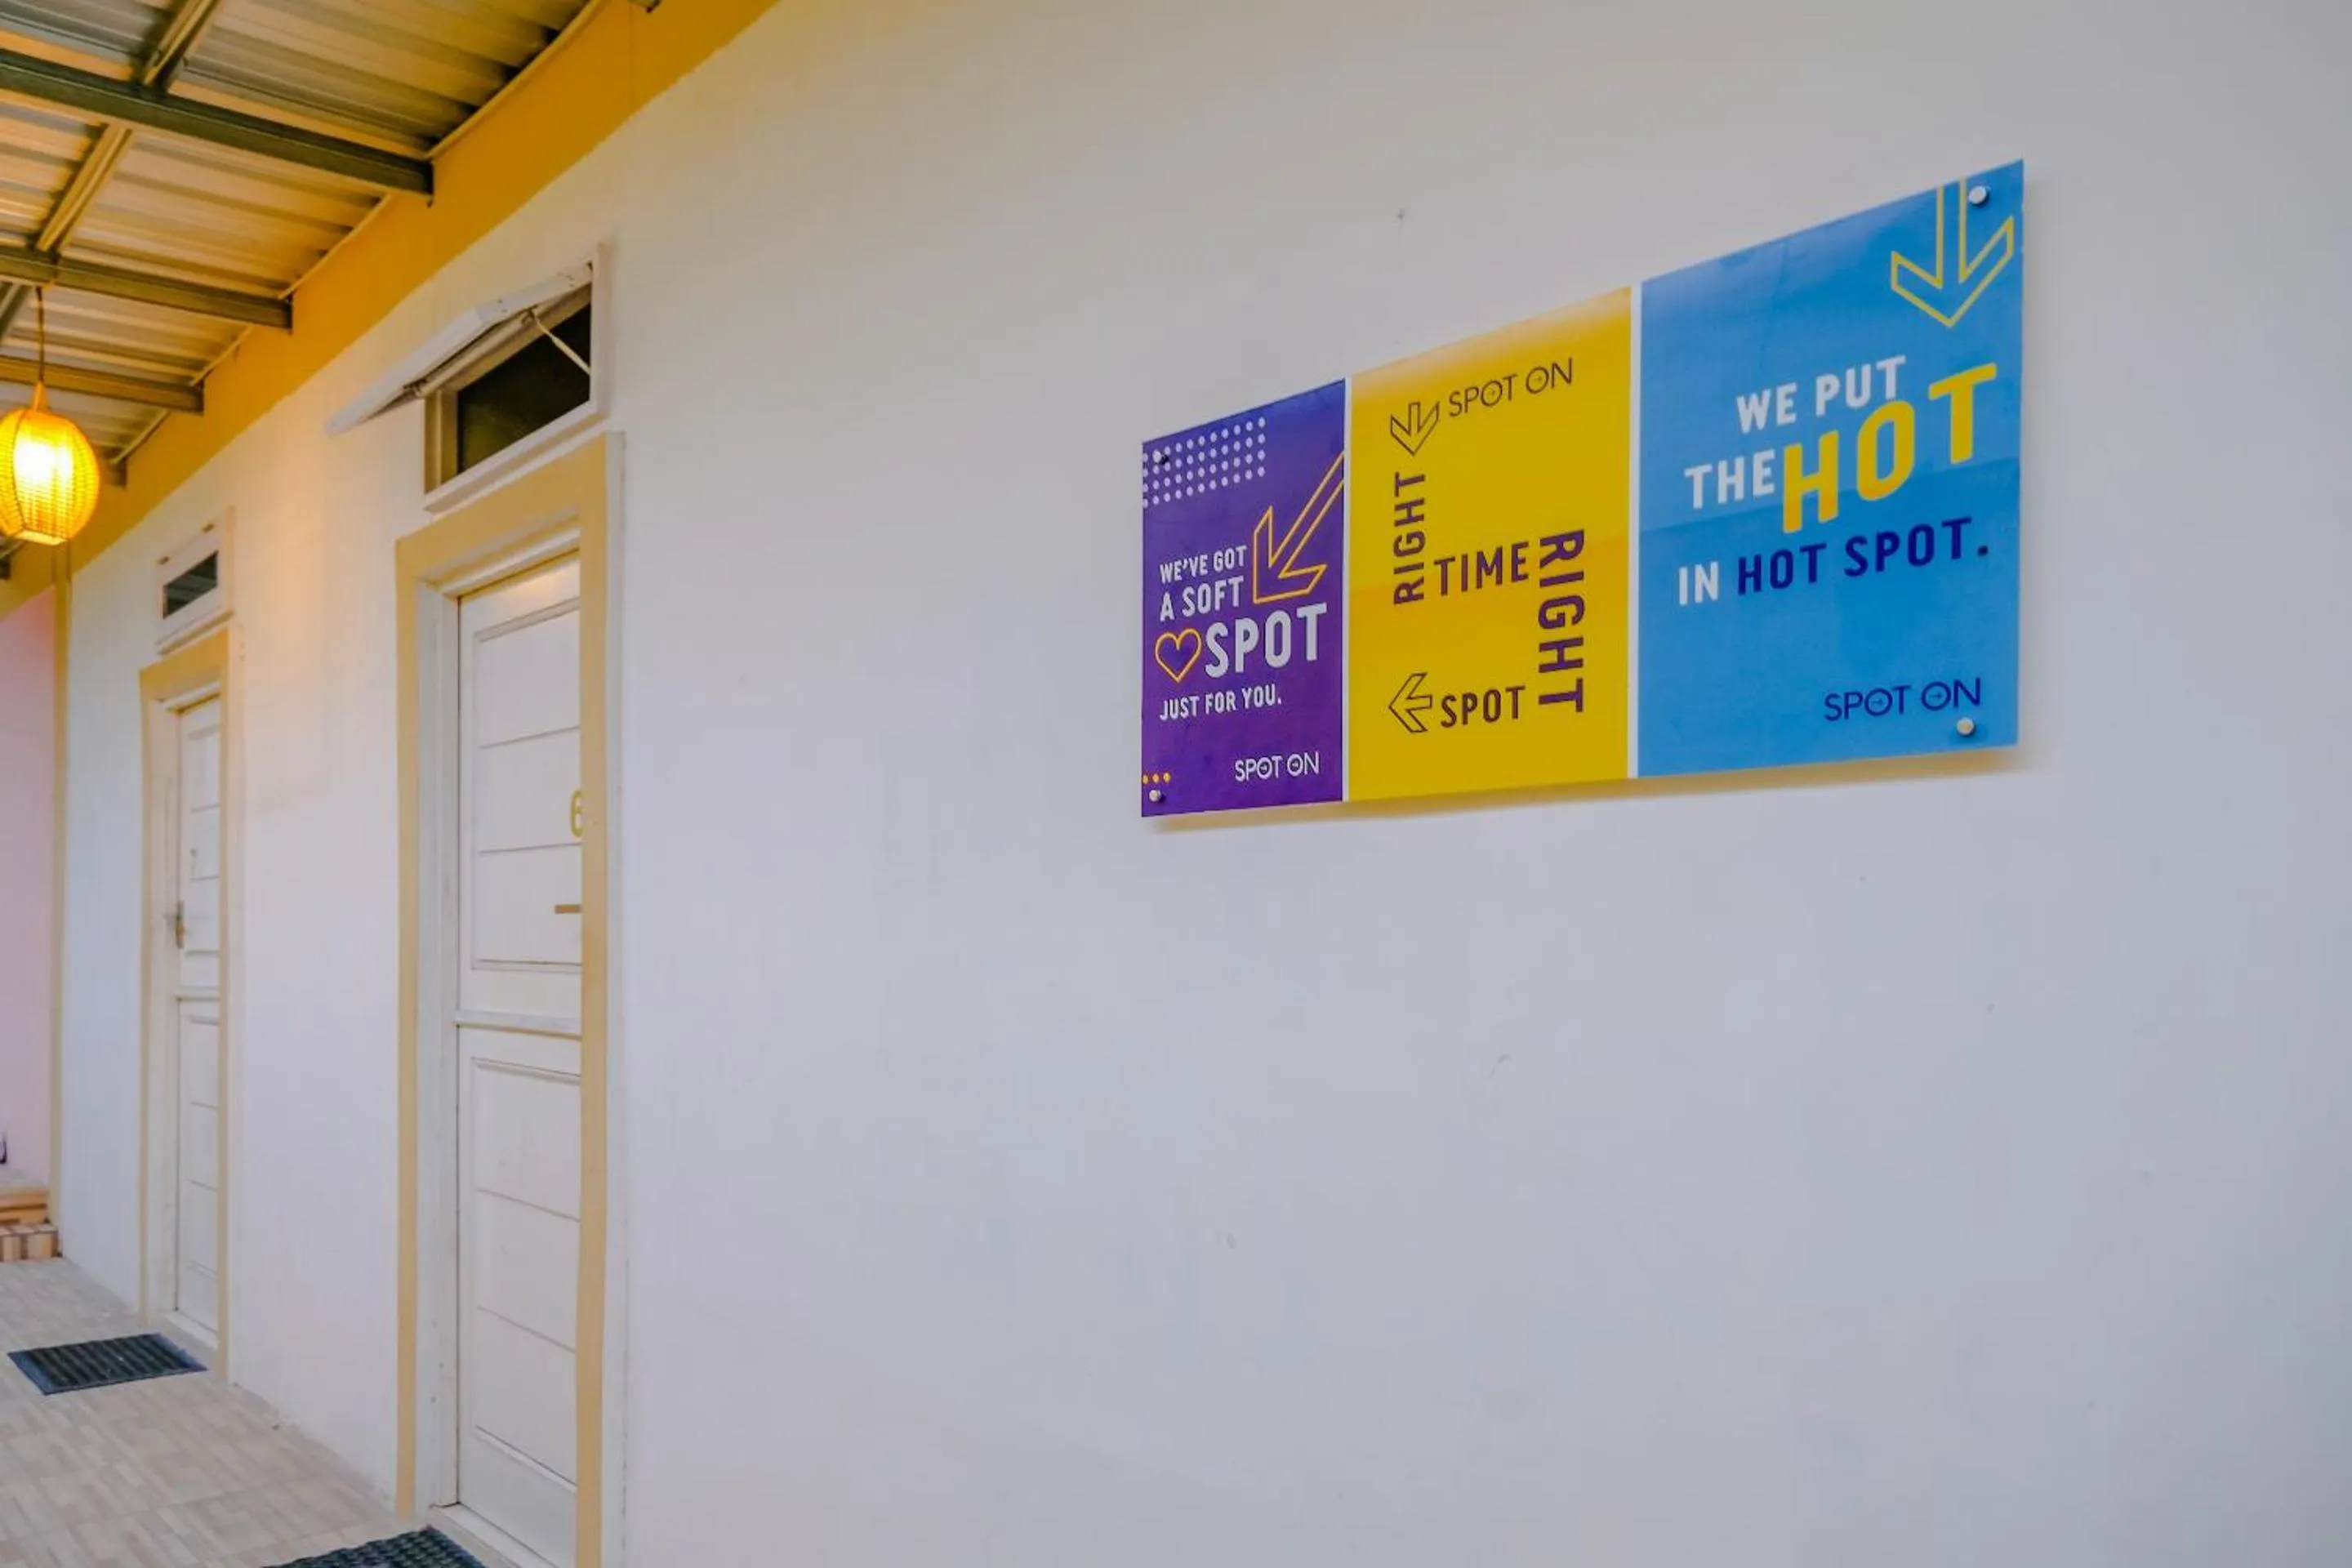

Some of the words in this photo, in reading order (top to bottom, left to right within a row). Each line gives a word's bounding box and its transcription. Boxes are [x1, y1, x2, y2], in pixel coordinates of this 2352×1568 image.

[1449, 372, 1519, 416] SPOT
[1526, 357, 1573, 394] ON
[1736, 382, 1797, 434] WE
[1815, 355, 1906, 416] PUT
[1685, 449, 1775, 509] THE
[1783, 363, 1998, 533] HOT
[1160, 555, 1208, 584] WE'VE
[1213, 545, 1247, 570] GOT
[1394, 471, 1426, 605] RIGHT
[1678, 561, 1718, 605] IN
[1738, 542, 1826, 595] HOT
[1844, 517, 1989, 579] SPOT.
[1433, 541, 1530, 596] TIME
[1160, 592, 1174, 621] A
[1182, 577, 1244, 617] SOFT
[1538, 529, 1584, 713] RIGHT
[1205, 603, 1327, 679] SPOT
[1160, 696, 1200, 721] JUST
[1205, 691, 1236, 715] FOR
[1241, 684, 1282, 710] YOU.
[1441, 686, 1526, 728] SPOT
[1824, 684, 1911, 721] SPOT
[1921, 677, 1981, 711] ON
[1235, 755, 1282, 782] SPOT
[1286, 751, 1320, 777] ON
